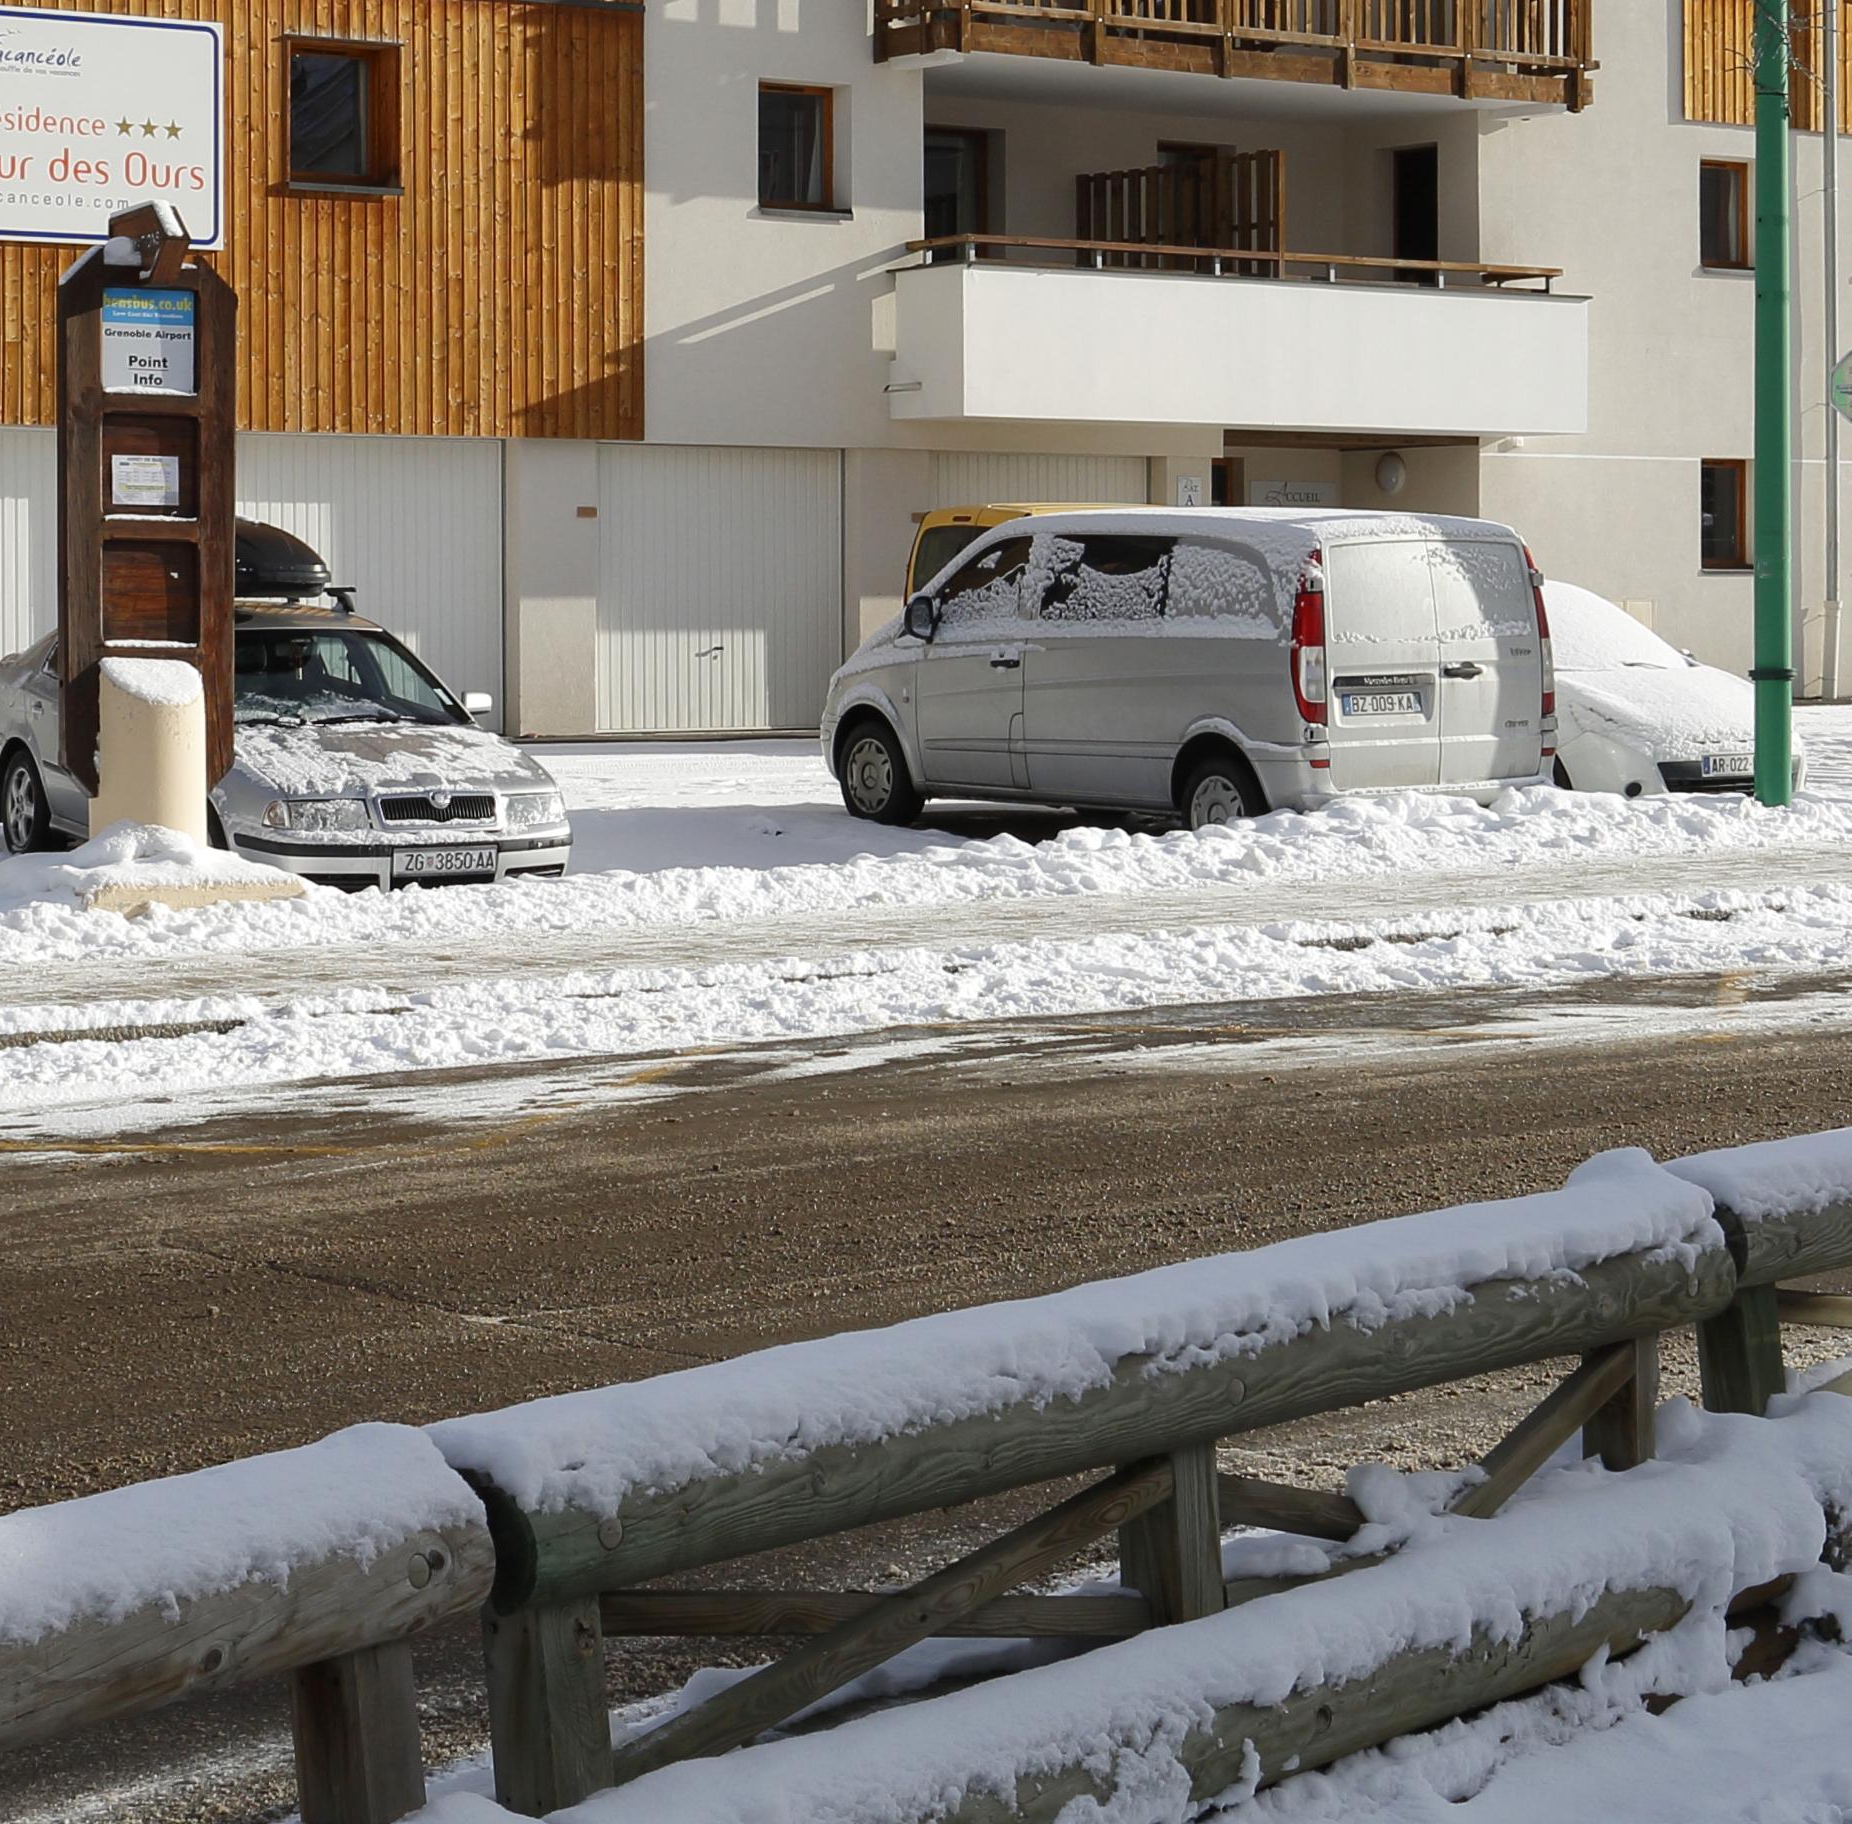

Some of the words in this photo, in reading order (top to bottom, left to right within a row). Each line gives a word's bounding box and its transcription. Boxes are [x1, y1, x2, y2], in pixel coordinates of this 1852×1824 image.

[48, 148, 109, 185] des
[124, 151, 205, 191] Ours
[104, 328, 152, 338] Grenoble
[155, 330, 191, 341] Airport
[128, 355, 168, 368] Point
[133, 373, 163, 386] Info
[1352, 695, 1413, 713] BZ-009-KA
[405, 853, 424, 871] ZG
